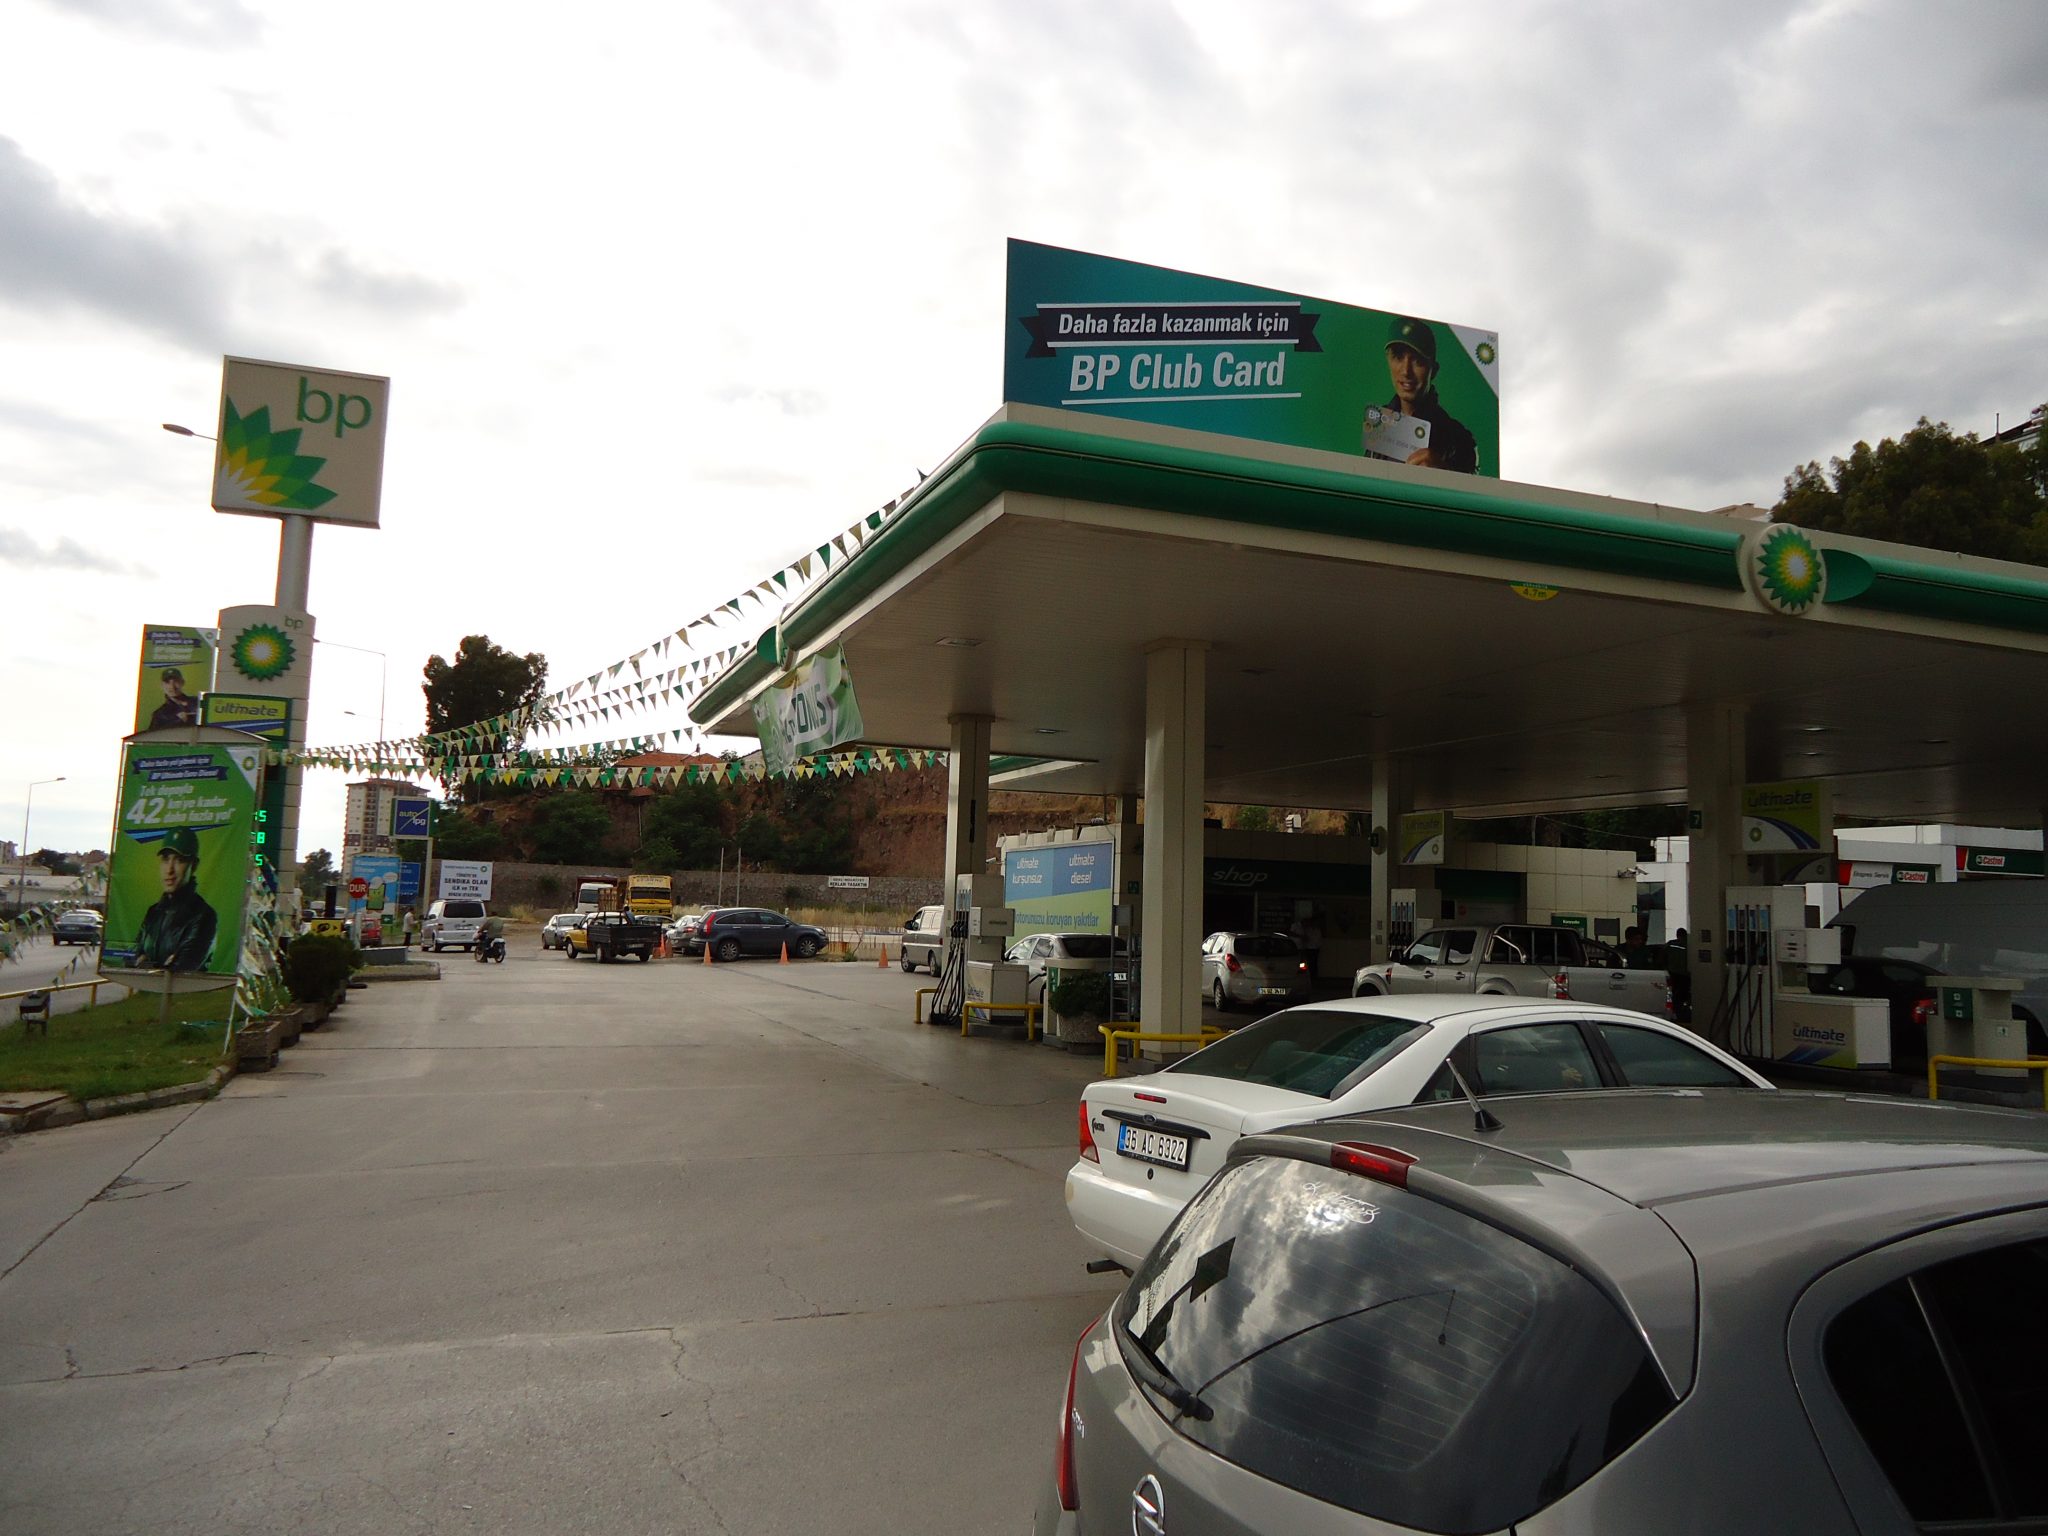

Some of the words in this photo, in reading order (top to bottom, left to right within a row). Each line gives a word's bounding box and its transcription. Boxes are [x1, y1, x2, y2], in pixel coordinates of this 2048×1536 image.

[1059, 313, 1107, 334] Daha
[1113, 313, 1157, 333] fazla
[1162, 312, 1253, 333] kazanmak
[1257, 312, 1290, 337] için
[1070, 354, 1121, 392] BP
[1129, 352, 1203, 391] Club
[1213, 351, 1286, 388] Card
[297, 376, 372, 438] bp
[284, 616, 304, 630] bp
[214, 701, 279, 717] ultimate
[1748, 790, 1813, 808] ultimate
[126, 798, 165, 825] 42
[1016, 857, 1040, 869] ultimate
[1068, 853, 1095, 867] ultimate
[1982, 856, 2004, 866] Castrol
[1070, 871, 1092, 885] diesel
[1211, 866, 1269, 887] shop
[1904, 872, 1927, 882] Castrol
[349, 883, 367, 893] DUR
[1015, 912, 1046, 925] otorunuzu
[1046, 910, 1073, 930] koruyan
[1793, 1026, 1845, 1041] ultimate
[1125, 1129, 1137, 1151] 35
[1141, 1132, 1155, 1155] AC
[1158, 1136, 1185, 1162] 6322
